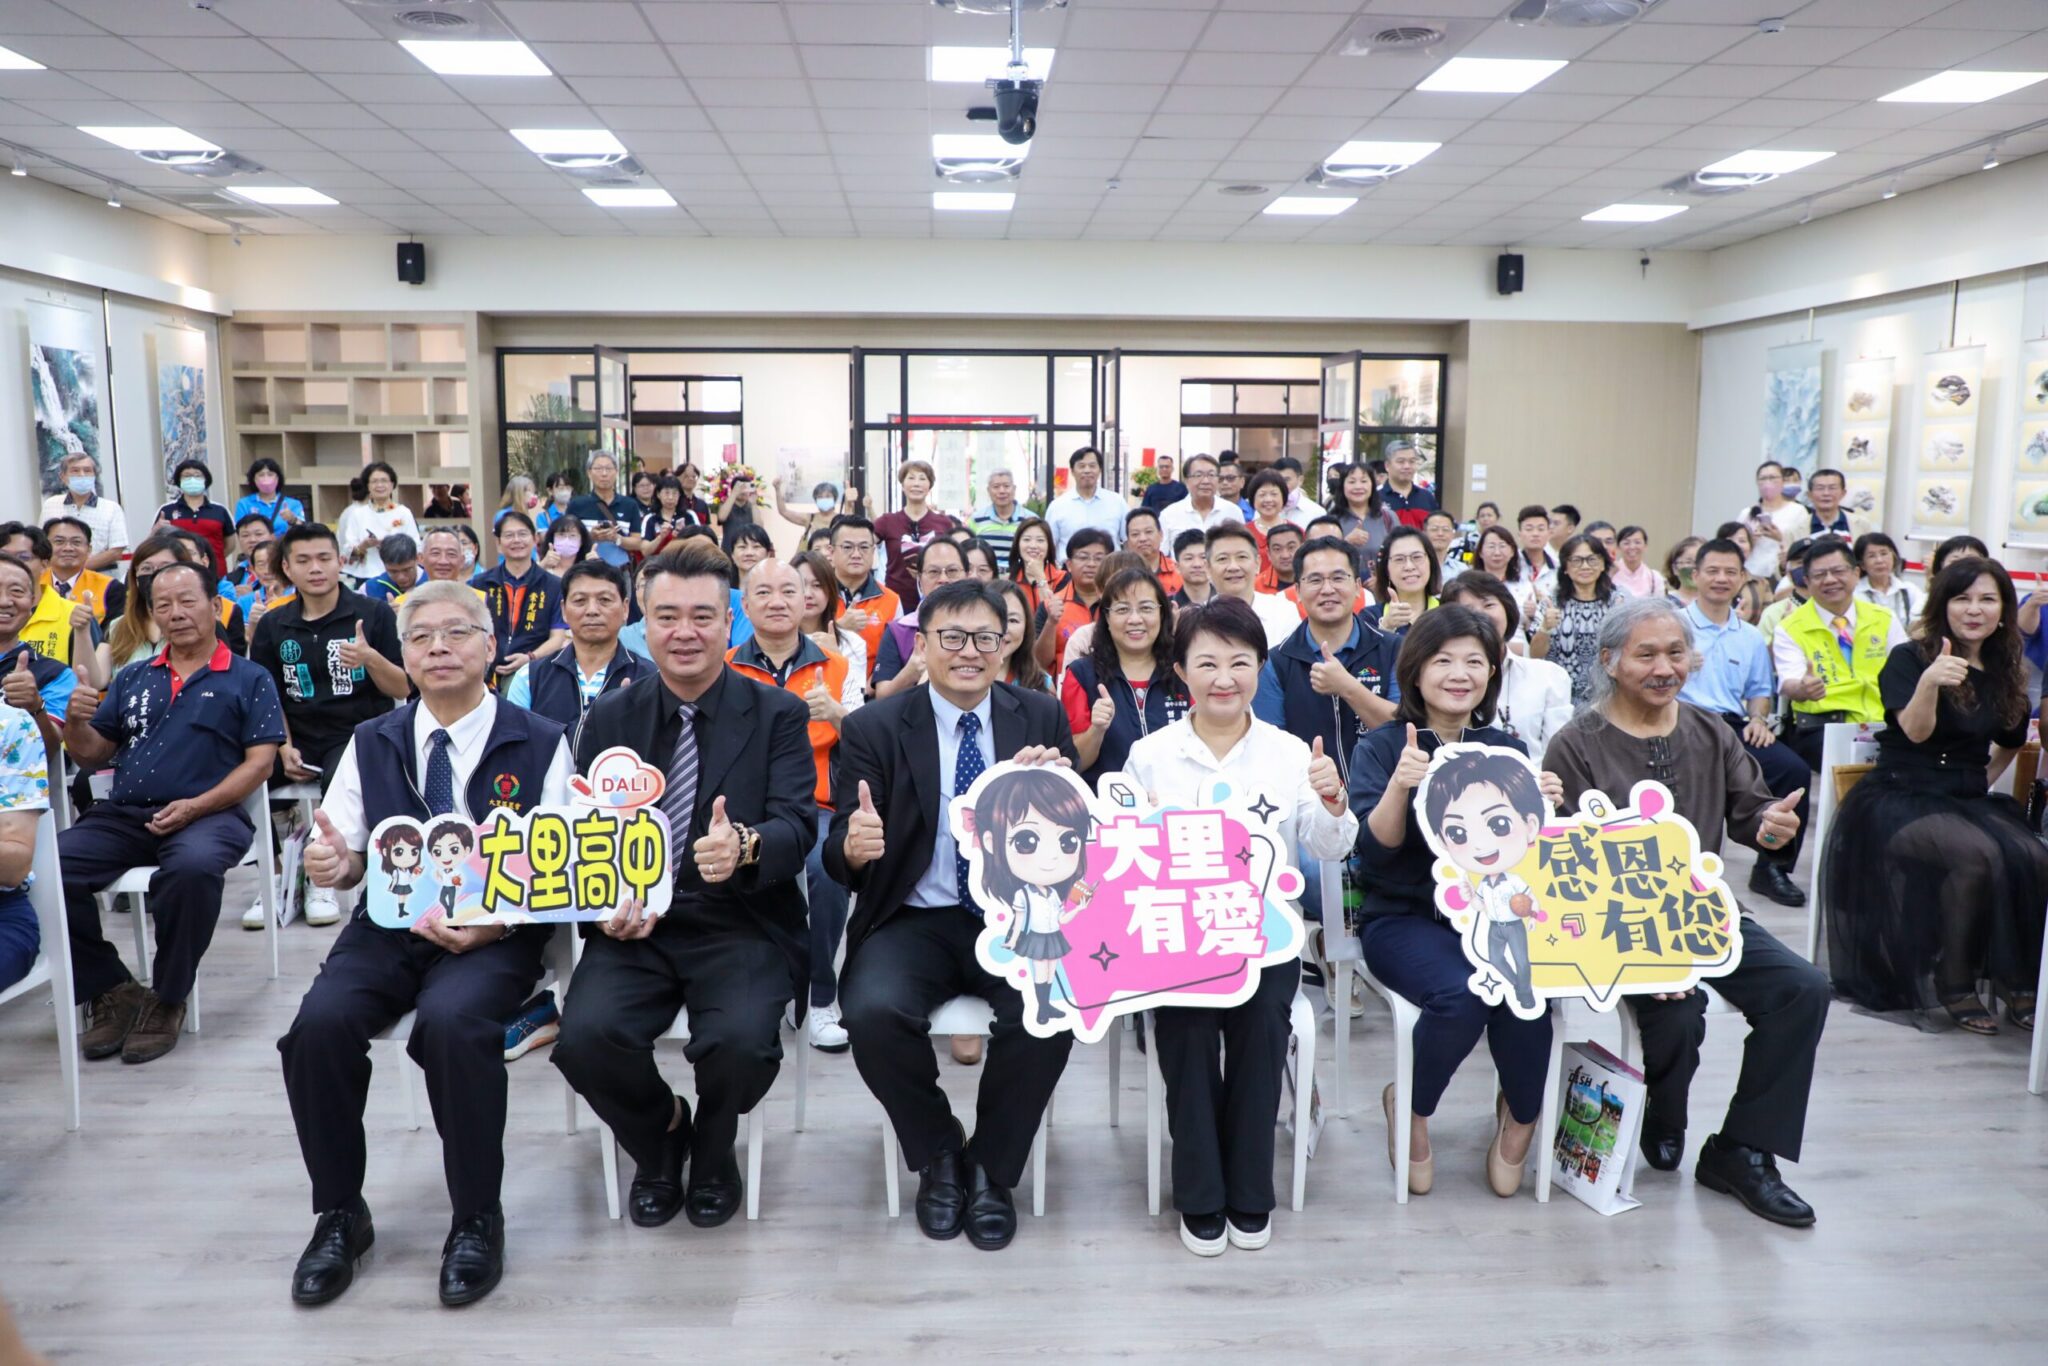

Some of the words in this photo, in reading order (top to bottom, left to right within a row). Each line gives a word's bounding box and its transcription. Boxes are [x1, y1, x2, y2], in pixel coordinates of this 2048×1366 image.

[47, 631, 58, 656] 執行長
[602, 777, 648, 792] DALI
[480, 808, 666, 913] 大里高中
[1099, 812, 1231, 882] 大里
[1538, 825, 1668, 902] 感恩
[1123, 882, 1266, 956] 有愛
[1596, 889, 1732, 957] 有您
